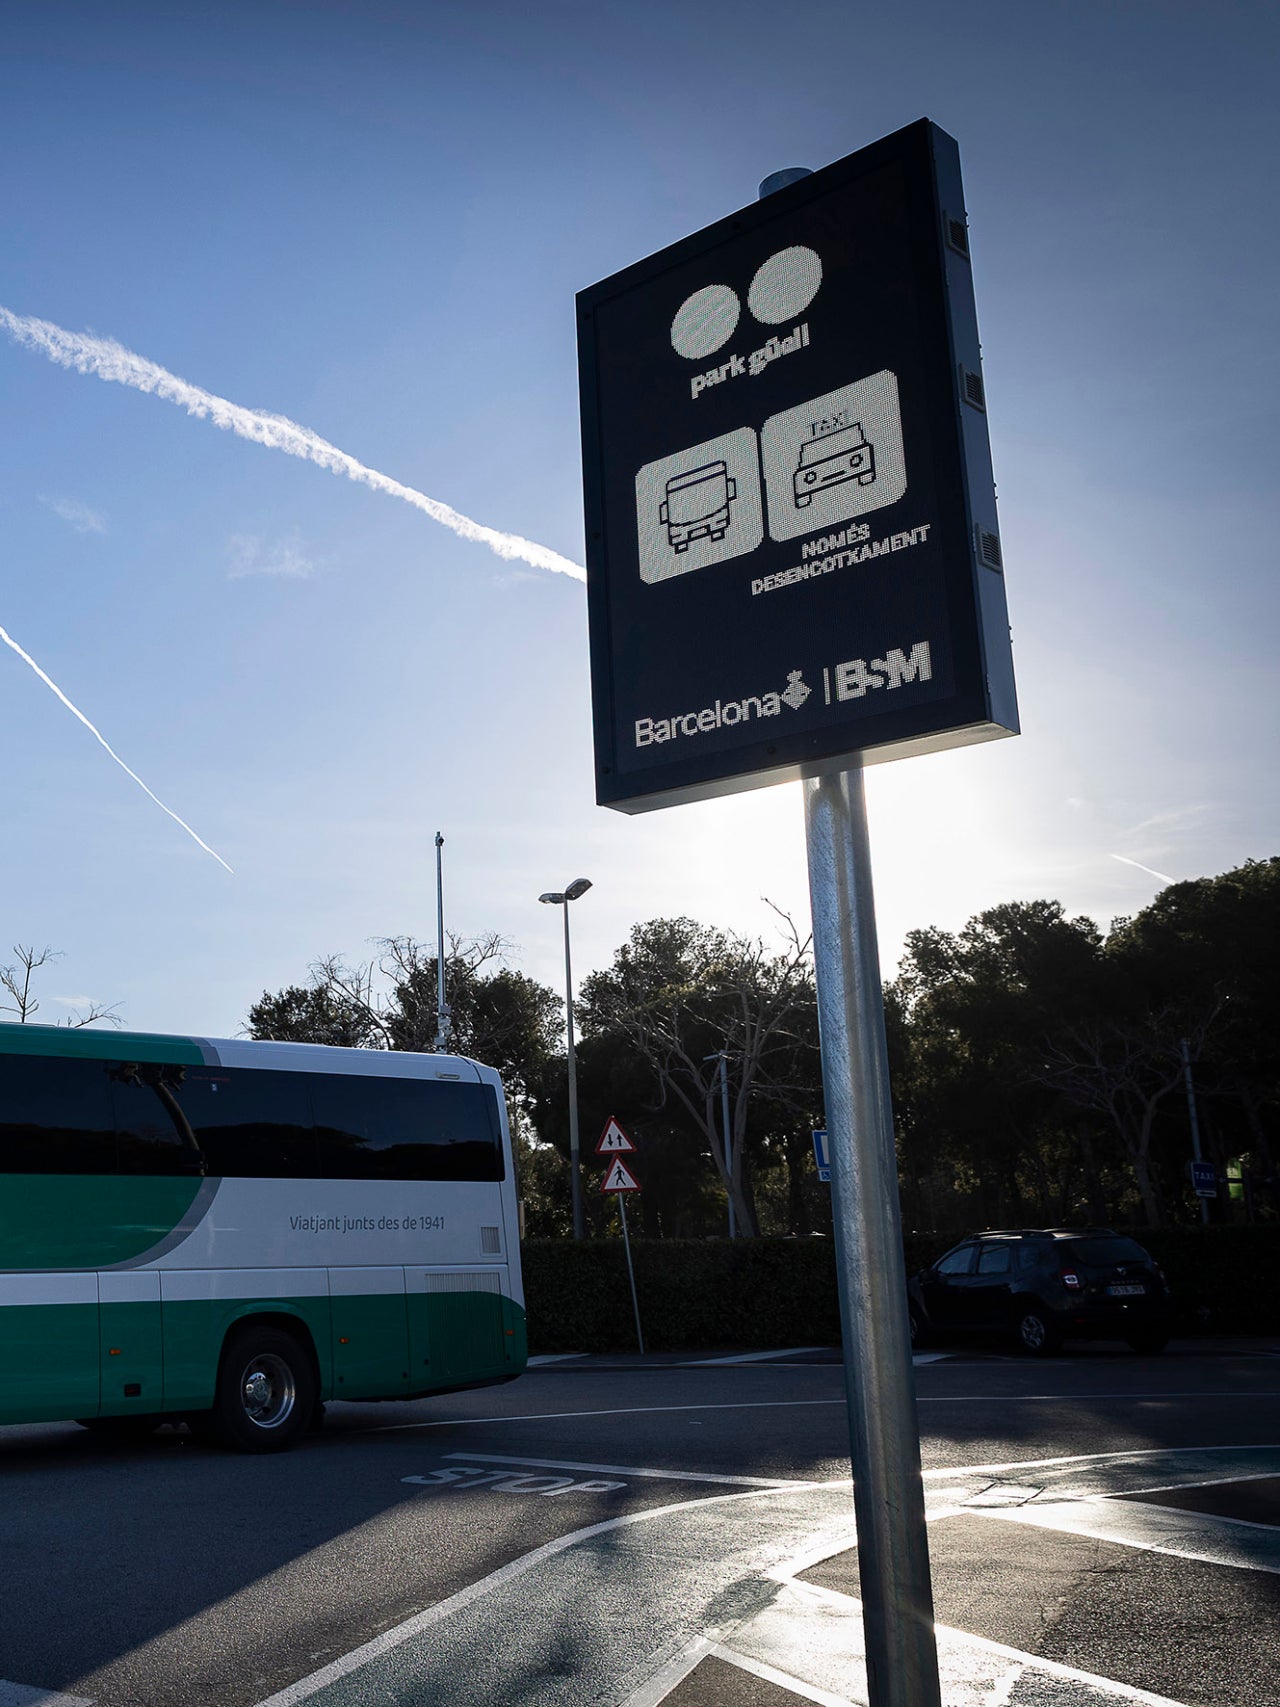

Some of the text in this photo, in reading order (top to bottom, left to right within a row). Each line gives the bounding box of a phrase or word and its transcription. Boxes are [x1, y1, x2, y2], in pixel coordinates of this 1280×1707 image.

[690, 322, 810, 400] park güell
[751, 523, 931, 596] DESENCOTXAMENT
[801, 522, 871, 559] NOMÉS
[634, 640, 933, 748] Barcelona BSM
[289, 1215, 445, 1234] Viatjant junts des de 1941
[400, 1466, 628, 1497] STOP
